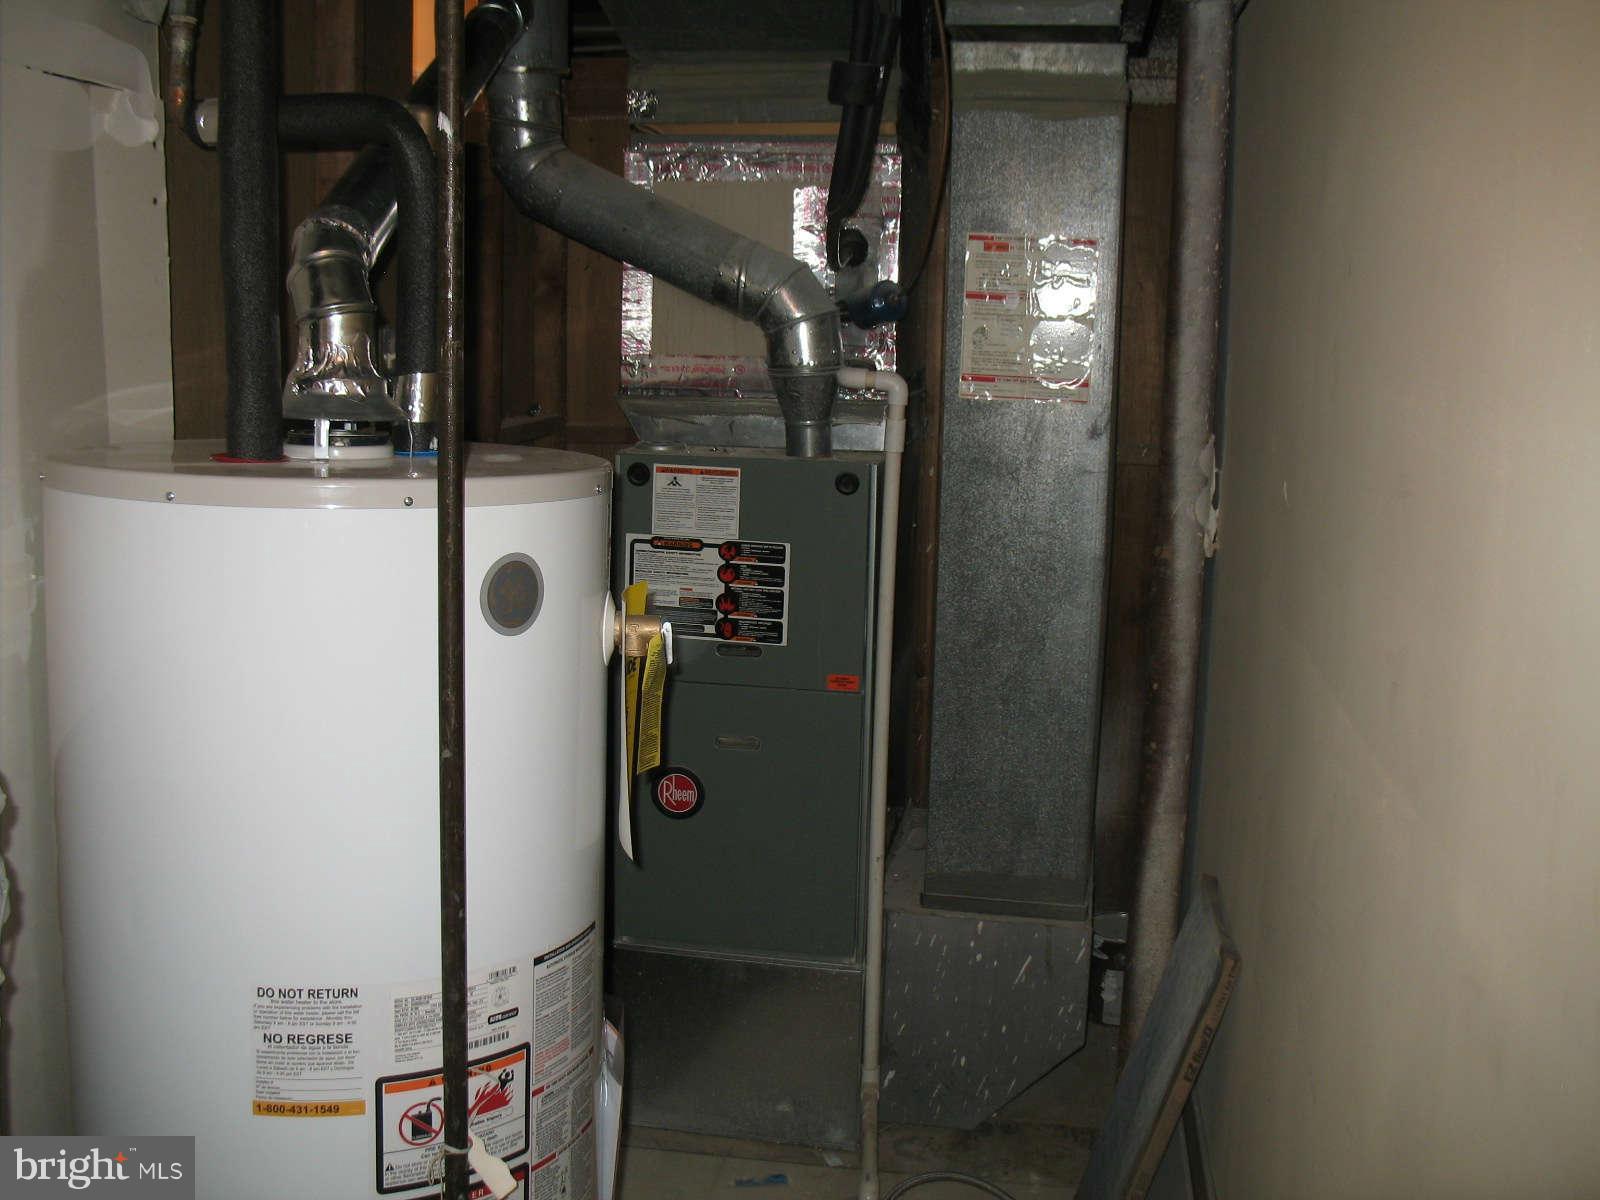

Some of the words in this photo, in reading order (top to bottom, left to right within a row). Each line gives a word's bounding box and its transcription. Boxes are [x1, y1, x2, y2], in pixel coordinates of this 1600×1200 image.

[664, 775, 695, 806] Rheem
[257, 987, 275, 998] DO
[278, 988, 304, 999] NOT
[307, 987, 358, 999] RETURN
[263, 1033, 283, 1044] NO
[287, 1033, 353, 1045] REGRESE
[255, 1103, 340, 1115] 1-800-431-1549
